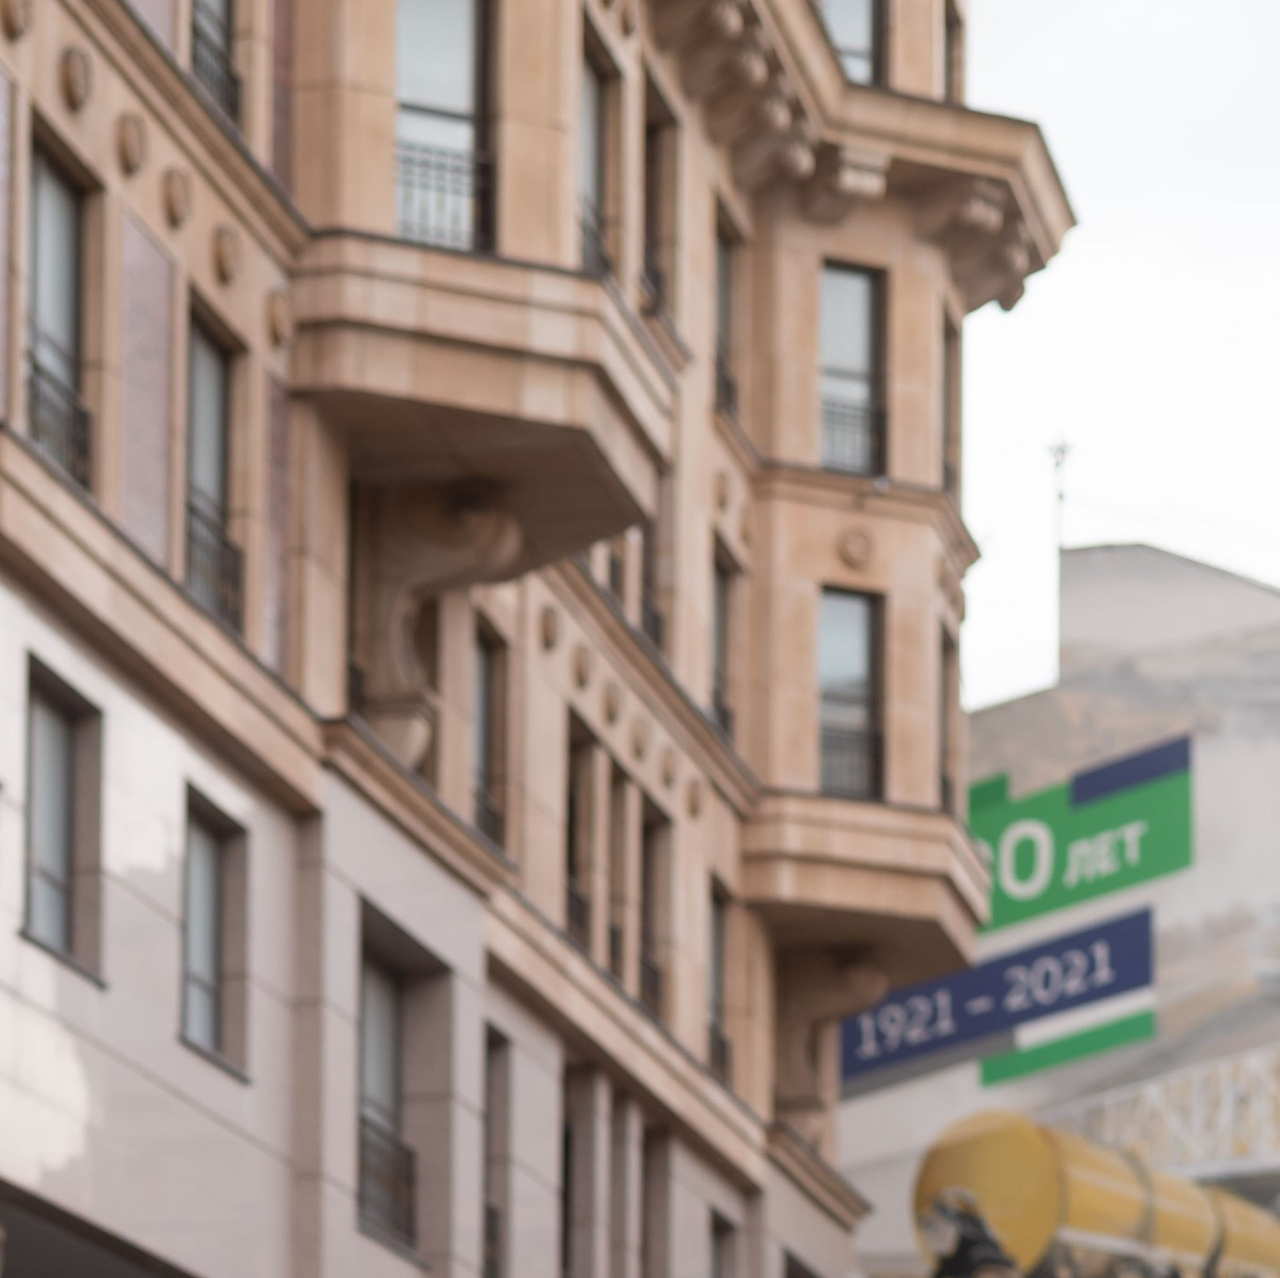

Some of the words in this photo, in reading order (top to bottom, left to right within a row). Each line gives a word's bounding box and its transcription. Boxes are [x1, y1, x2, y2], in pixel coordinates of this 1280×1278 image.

[974, 818, 1055, 901] 0
[854, 988, 957, 1061] 1921
[1003, 941, 1115, 1012] 2021
